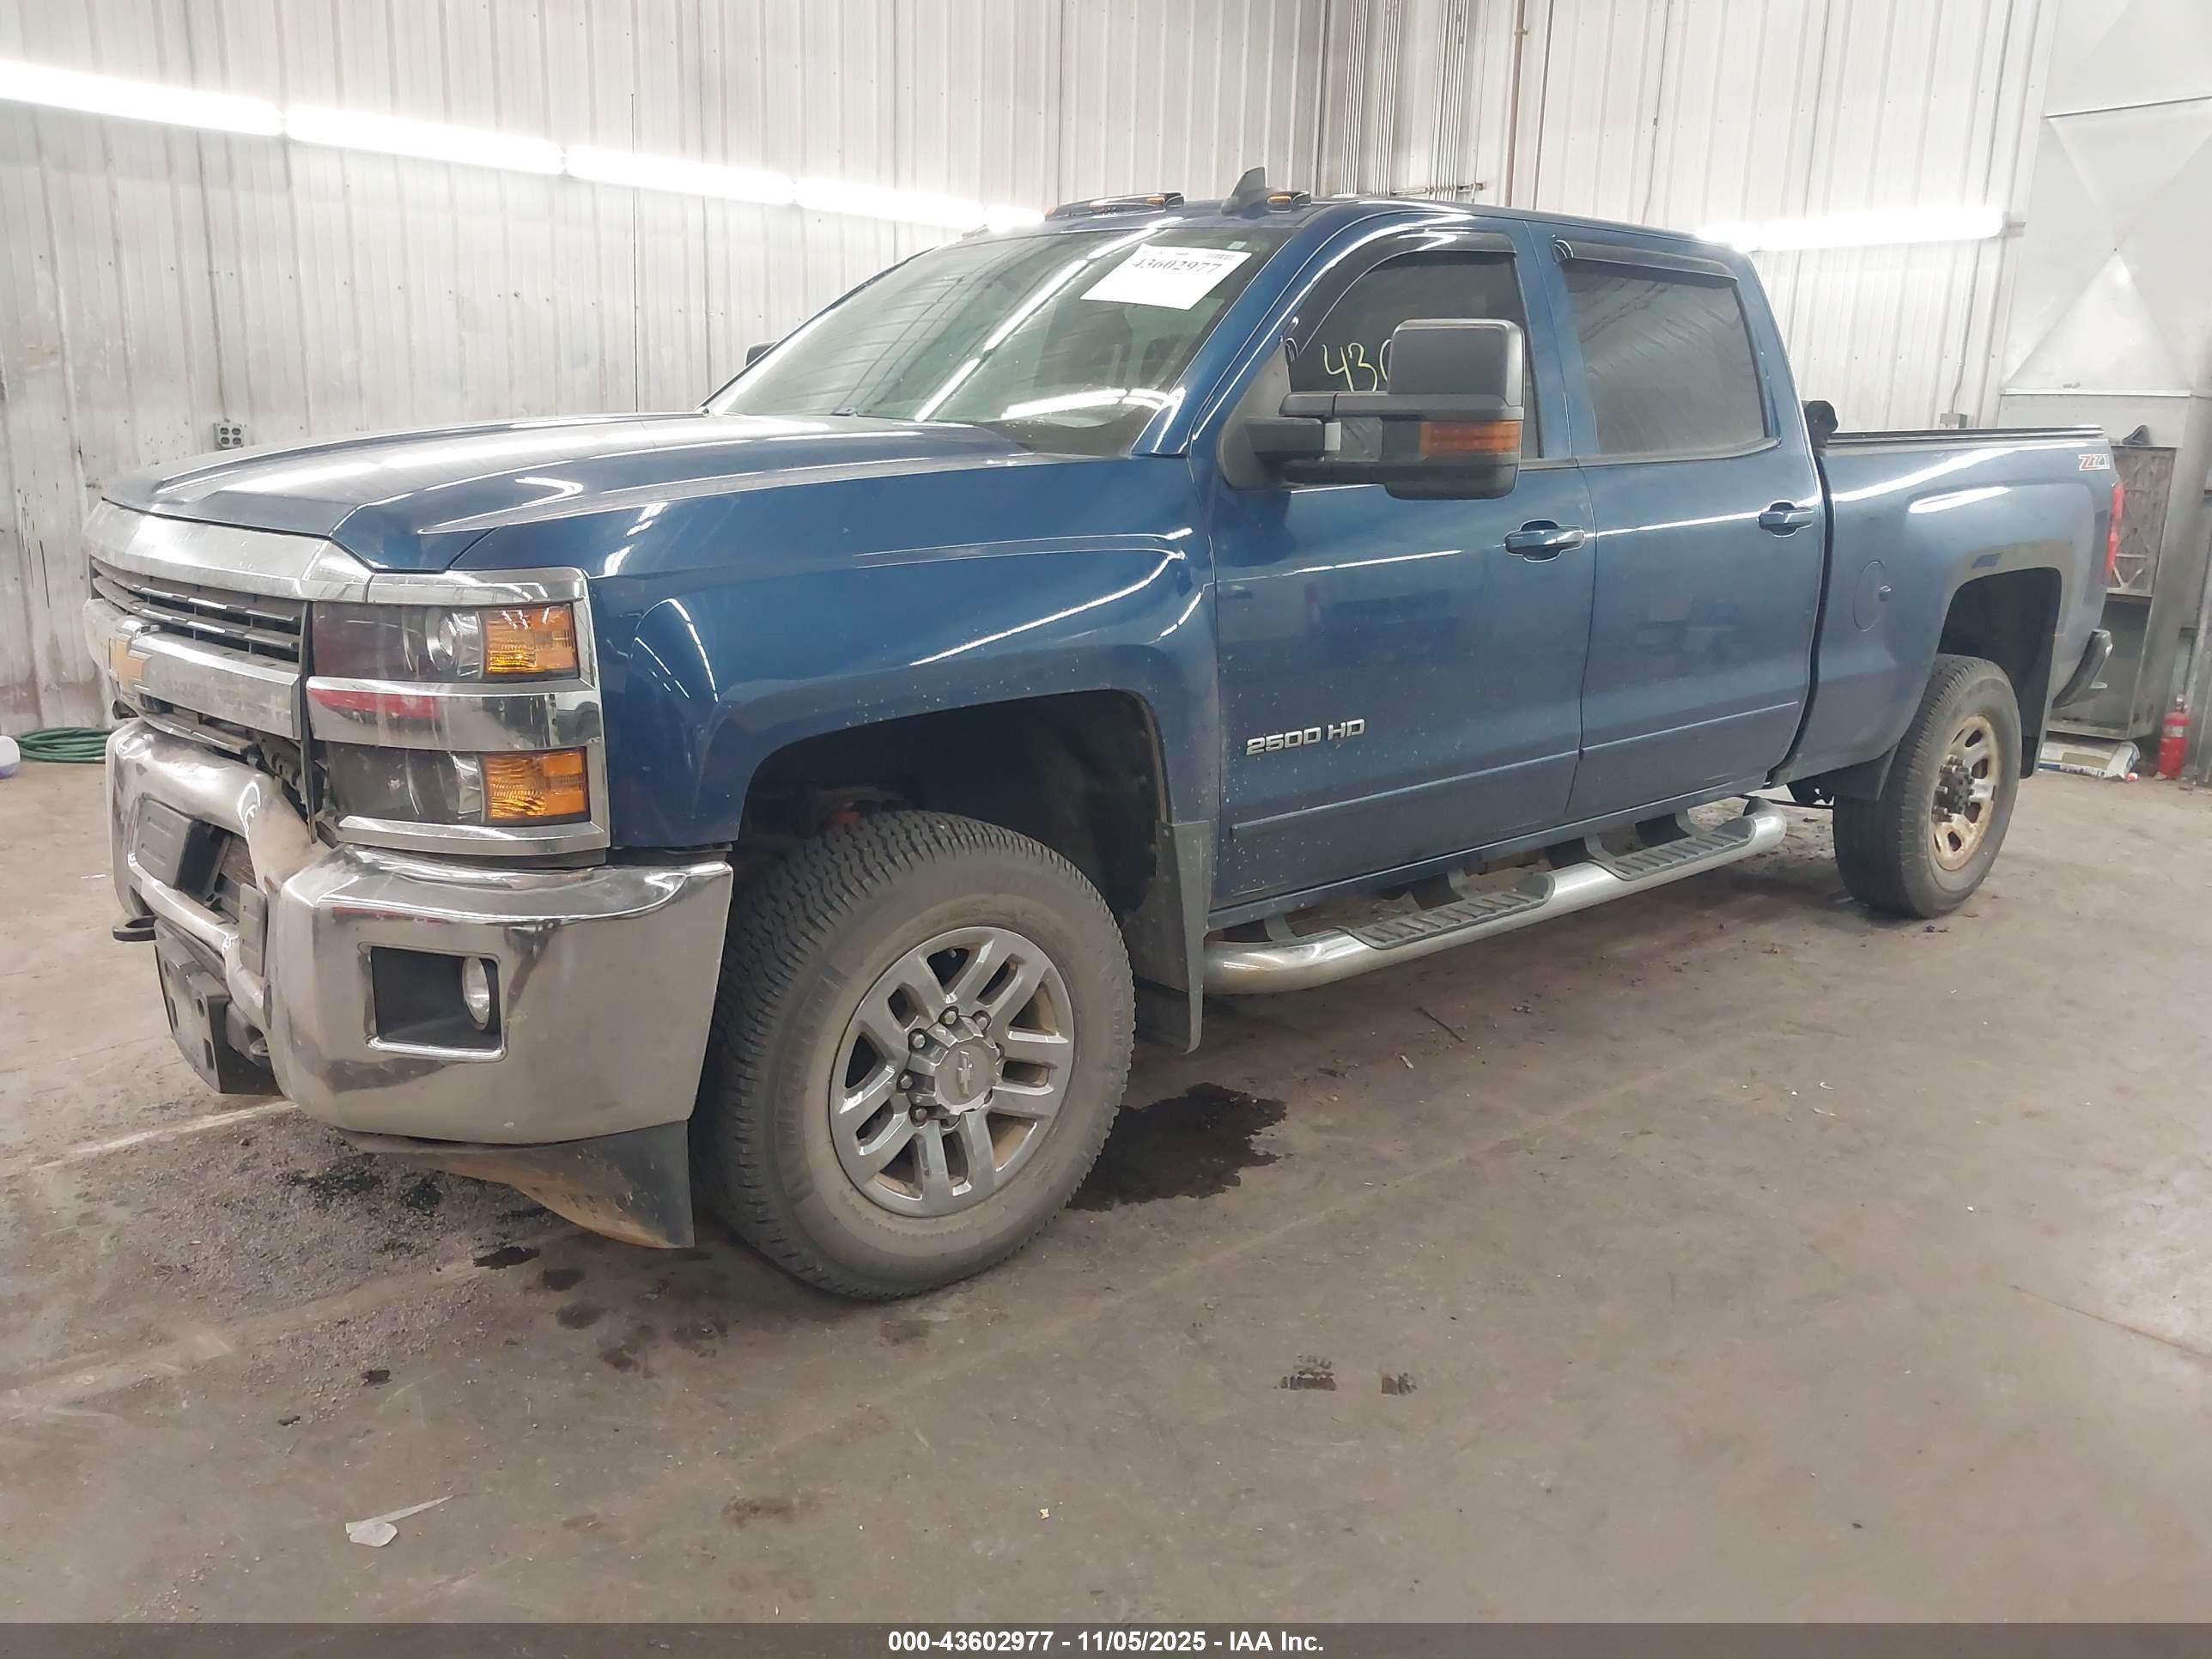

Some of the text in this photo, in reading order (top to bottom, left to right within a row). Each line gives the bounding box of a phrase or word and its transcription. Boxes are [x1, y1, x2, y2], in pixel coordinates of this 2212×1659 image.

[1132, 258, 1223, 274] 43602977
[1245, 718, 1365, 756] 2500 HD
